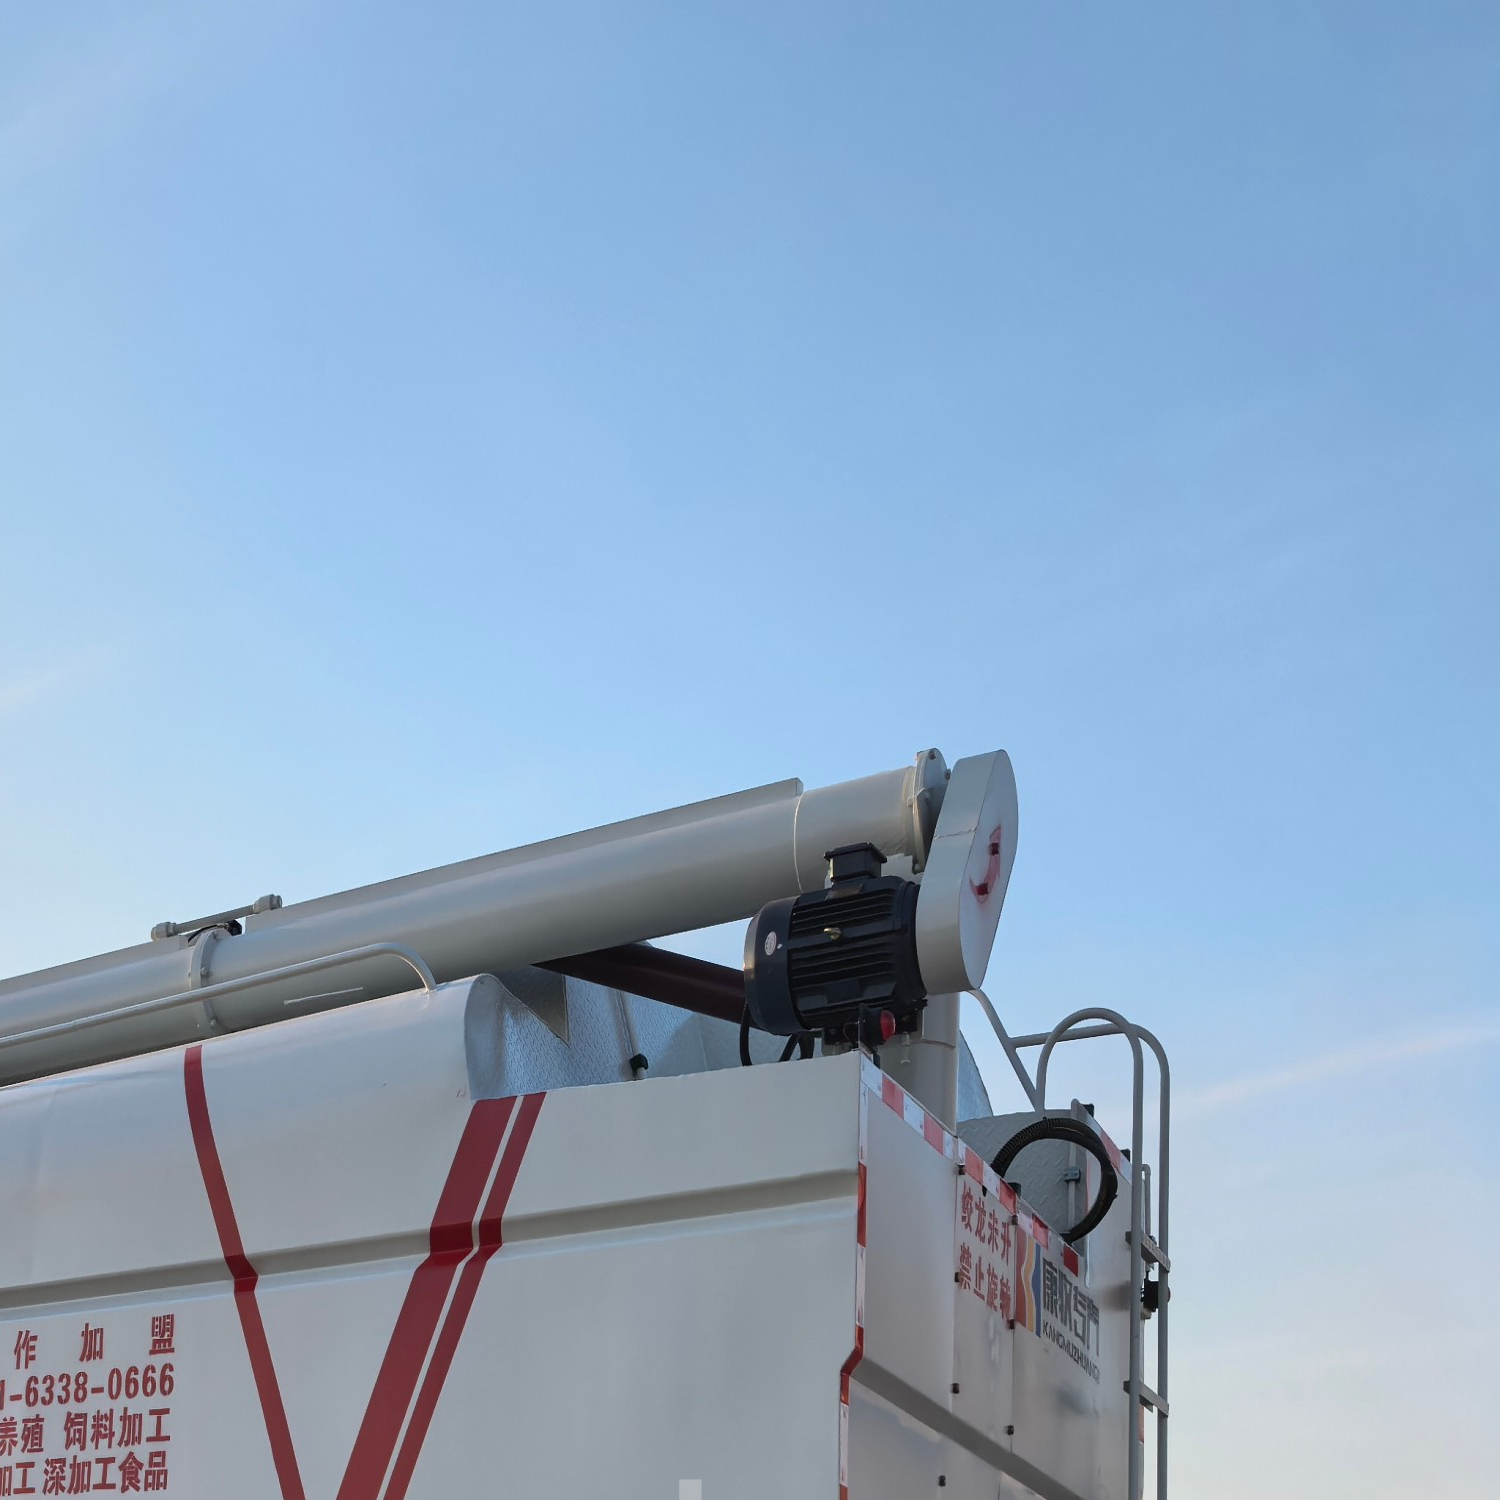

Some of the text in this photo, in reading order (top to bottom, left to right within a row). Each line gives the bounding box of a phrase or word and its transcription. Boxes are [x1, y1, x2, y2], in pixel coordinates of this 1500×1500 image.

[63, 1407, 171, 1452] 饲料加工
[42, 1450, 169, 1496] 深加工食品
